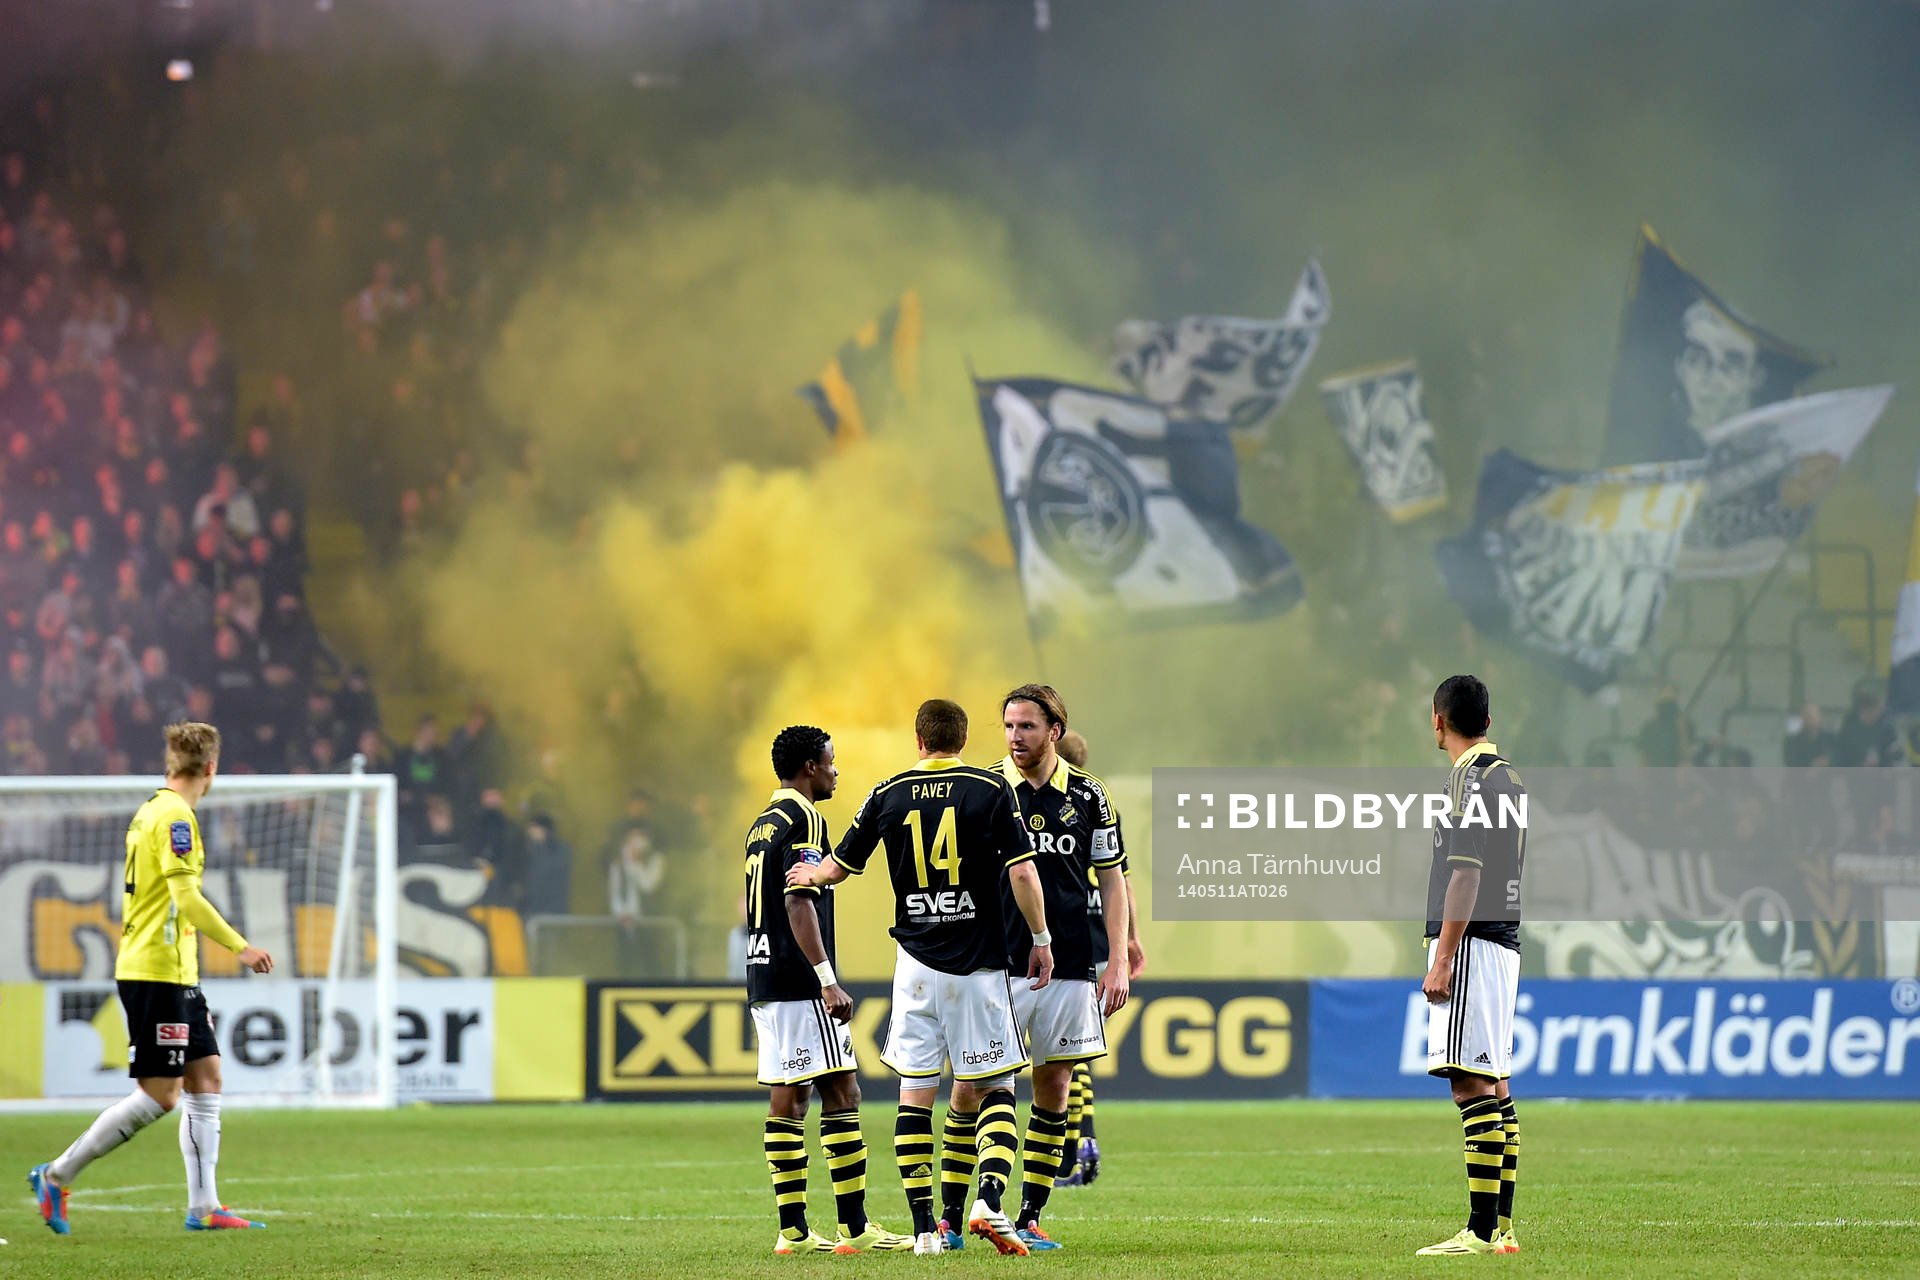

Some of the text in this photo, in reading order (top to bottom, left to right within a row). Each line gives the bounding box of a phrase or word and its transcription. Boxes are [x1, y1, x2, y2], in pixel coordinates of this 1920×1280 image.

[911, 782, 954, 800] PAVEY
[902, 806, 963, 888] 14
[1028, 832, 1077, 855] BRO
[1107, 830, 1121, 851] C
[905, 891, 976, 915] SVEA
[942, 911, 976, 923] EKONOMI
[212, 988, 481, 1067] eber
[1096, 996, 1291, 1078] YGG
[168, 1050, 185, 1066] 24
